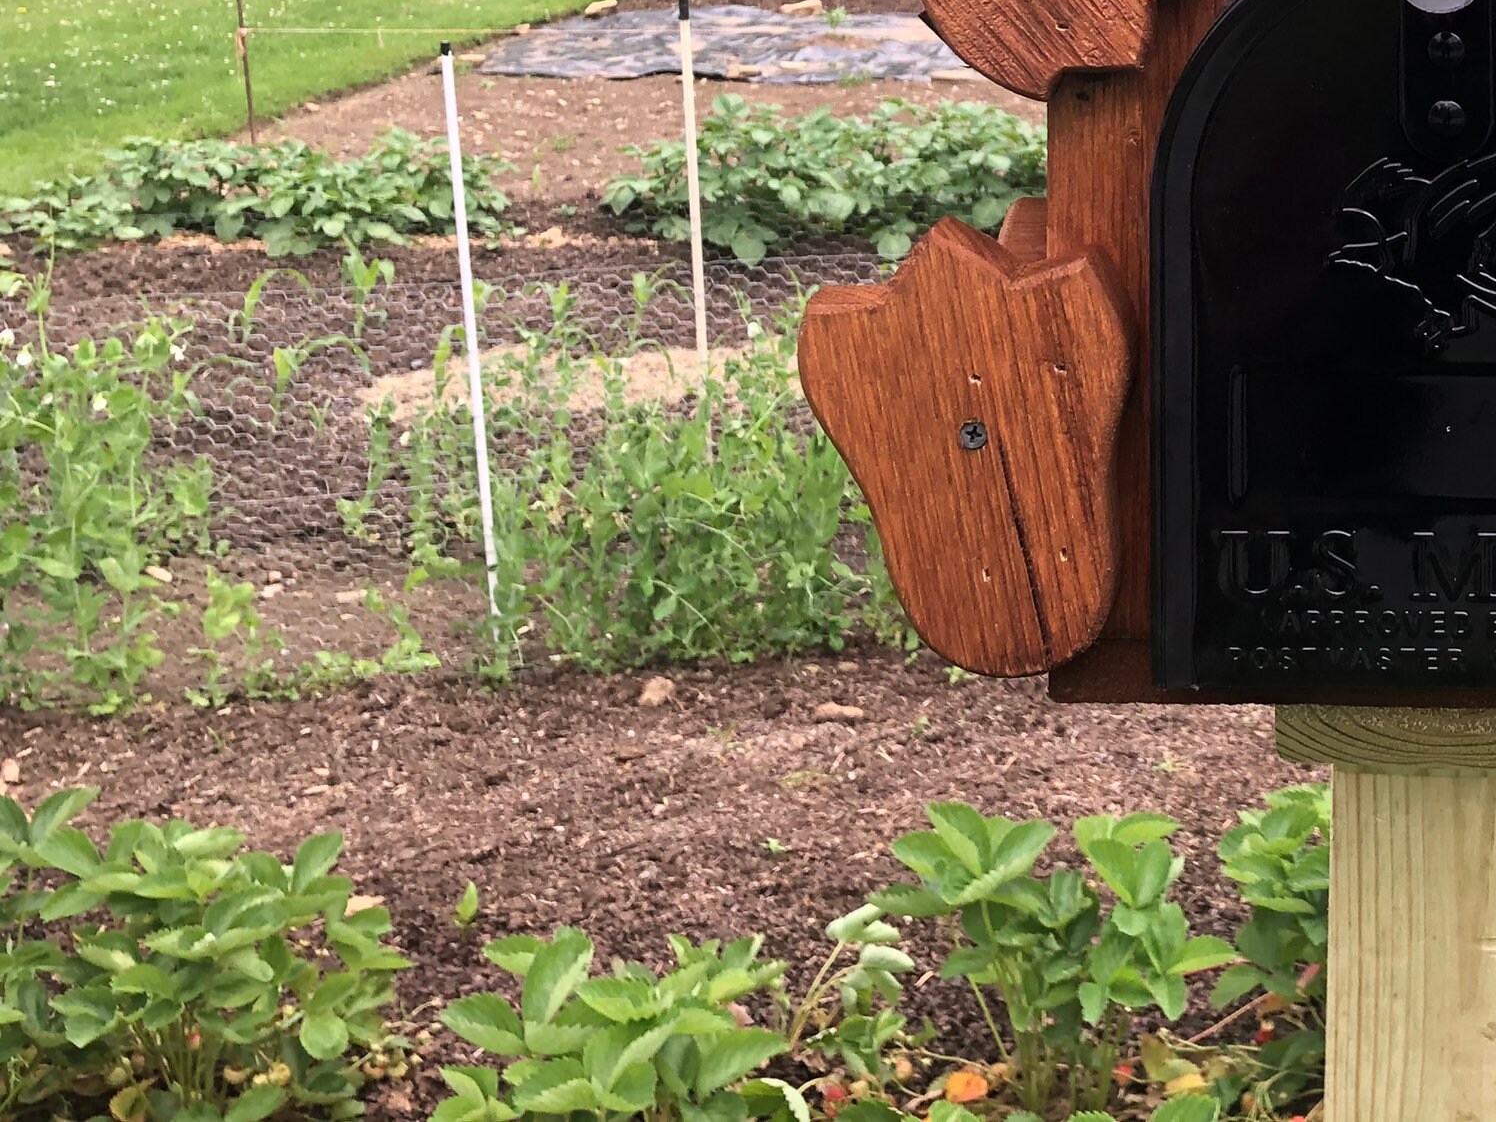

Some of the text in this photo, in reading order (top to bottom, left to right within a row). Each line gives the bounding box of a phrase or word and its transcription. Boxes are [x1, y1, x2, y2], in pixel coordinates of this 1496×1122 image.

[1219, 530, 1382, 601] U.S.
[1280, 610, 1470, 635] APPROVED
[1228, 645, 1466, 669] POSTMASTER
